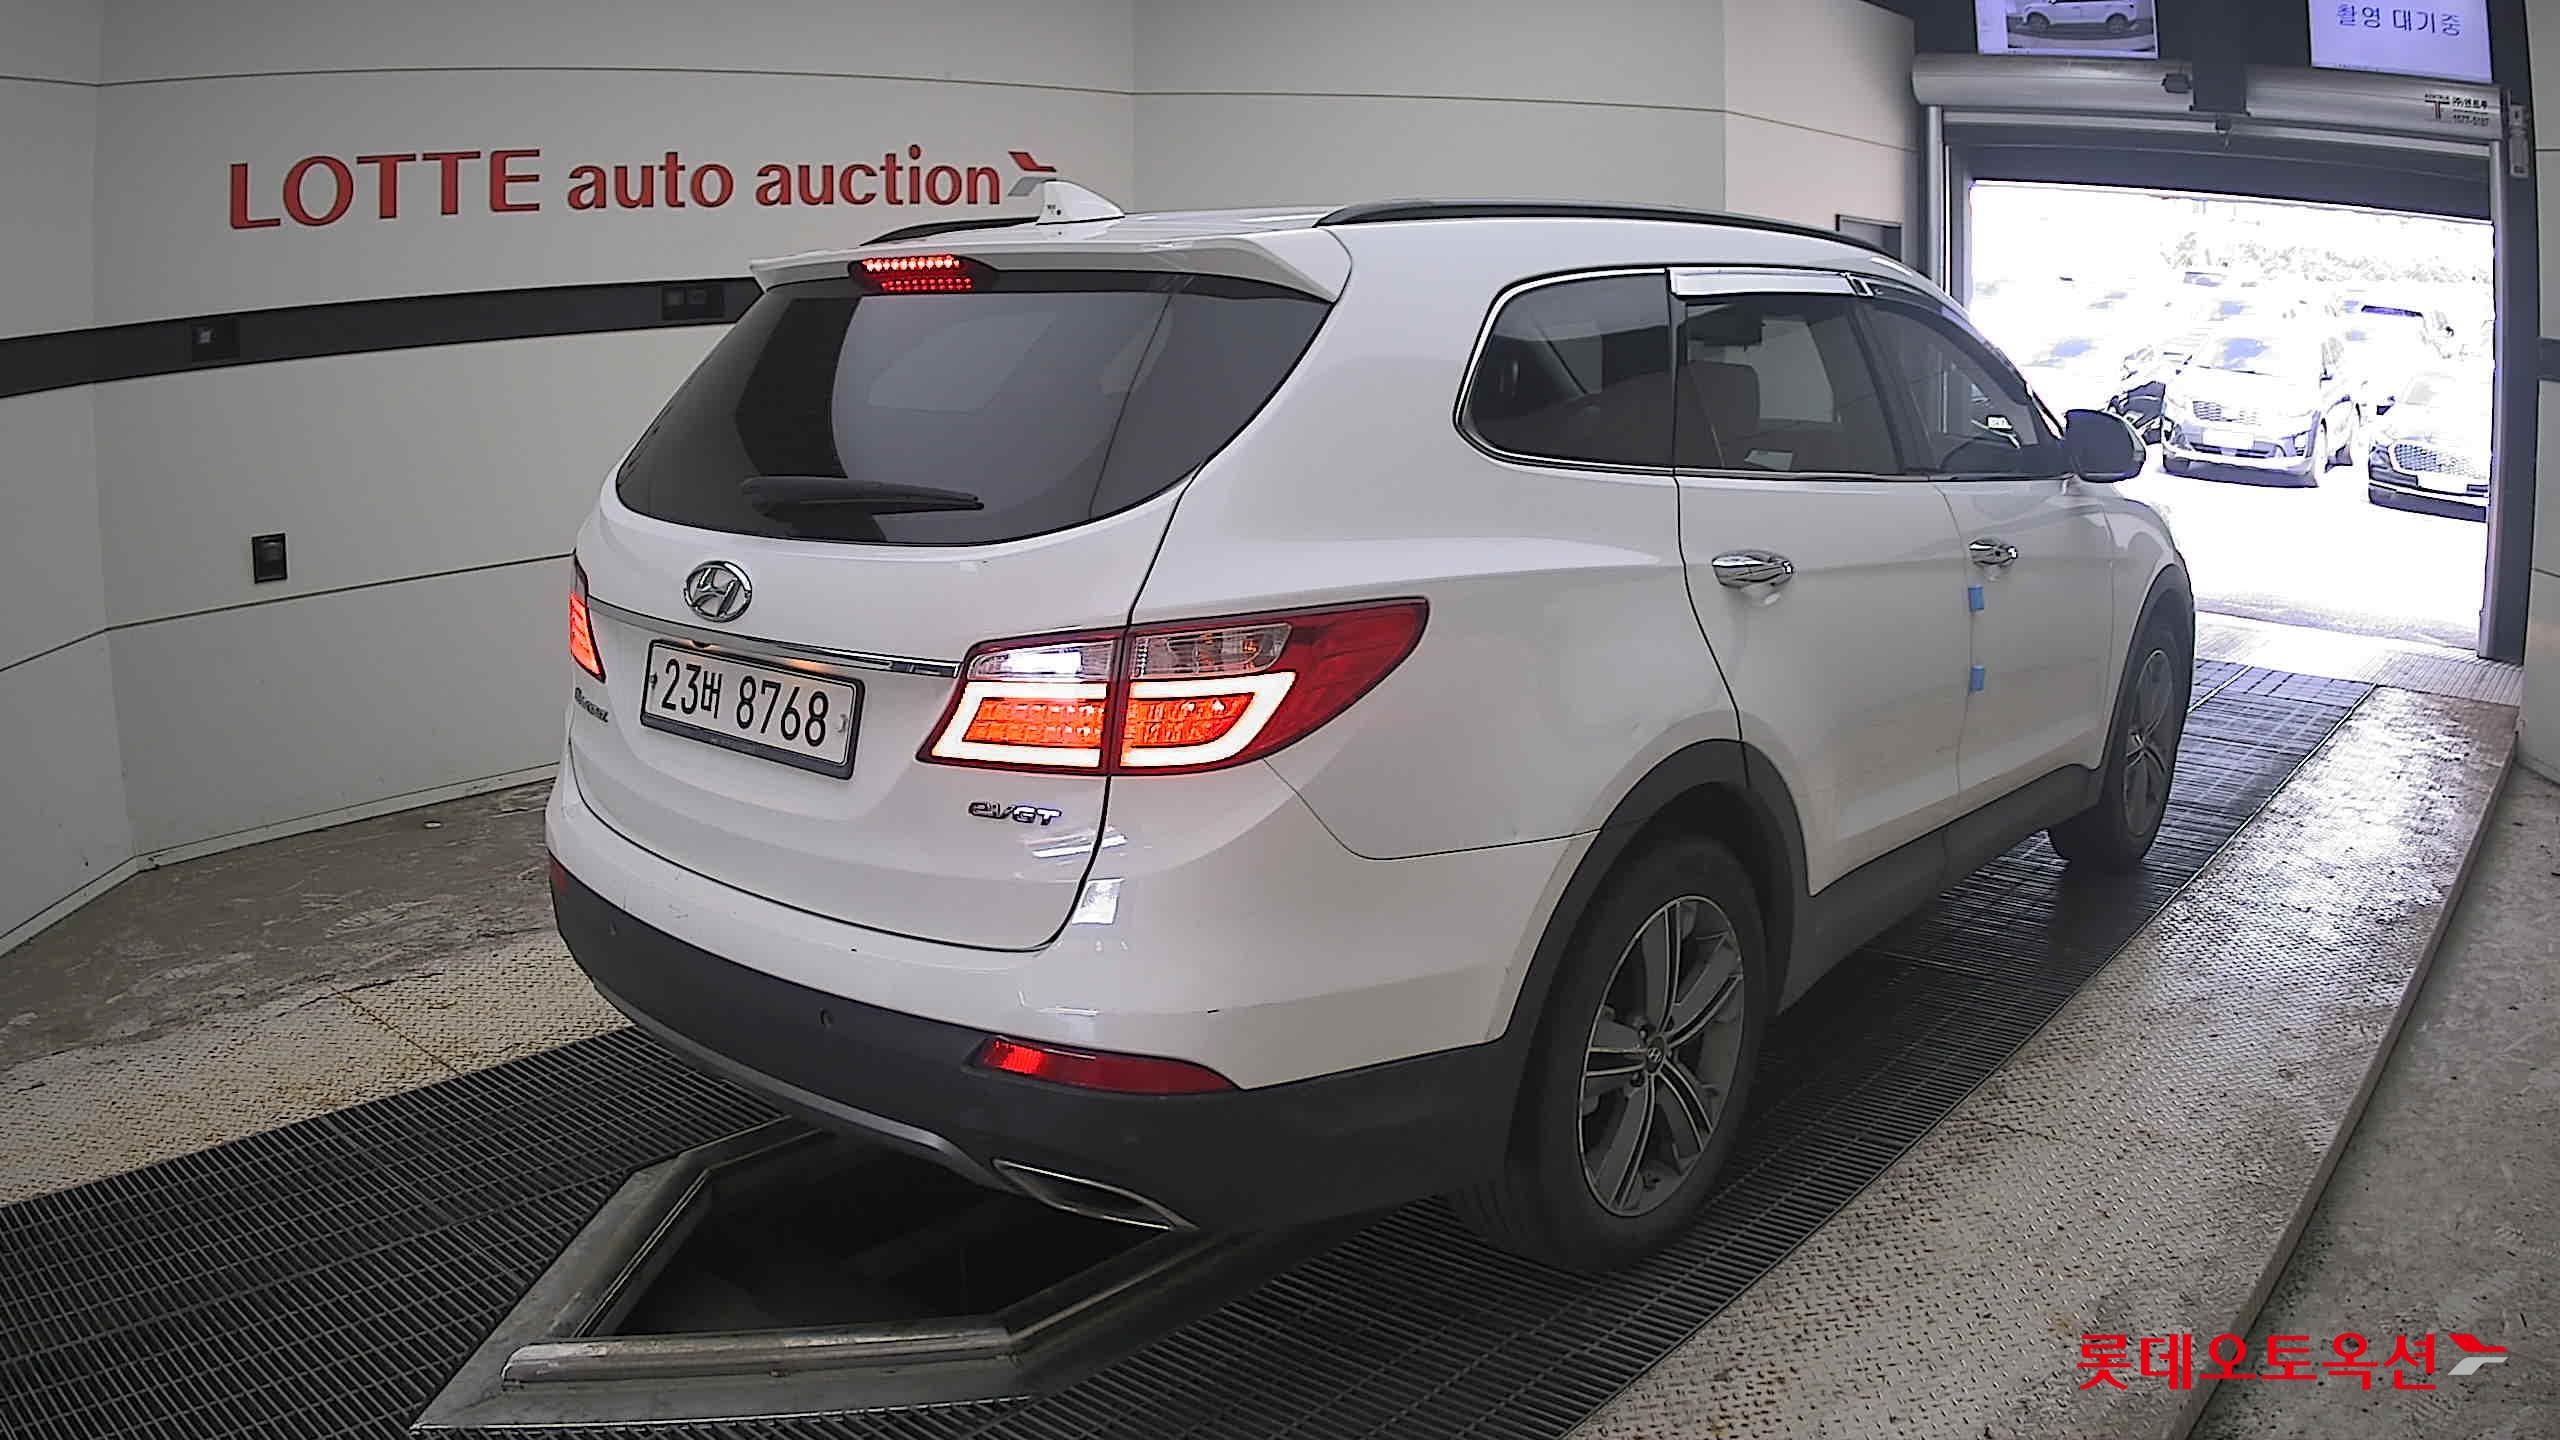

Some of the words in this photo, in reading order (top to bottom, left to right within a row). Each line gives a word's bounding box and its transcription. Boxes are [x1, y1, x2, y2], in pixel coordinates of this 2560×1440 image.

[2338, 4, 2381, 28] 촬영
[2393, 8, 2460, 36] 대기중
[230, 149, 540, 229] LOTTE
[567, 151, 734, 209] auto
[755, 144, 1000, 206] auction
[661, 659, 722, 719] 23버
[736, 675, 829, 747] 8768
